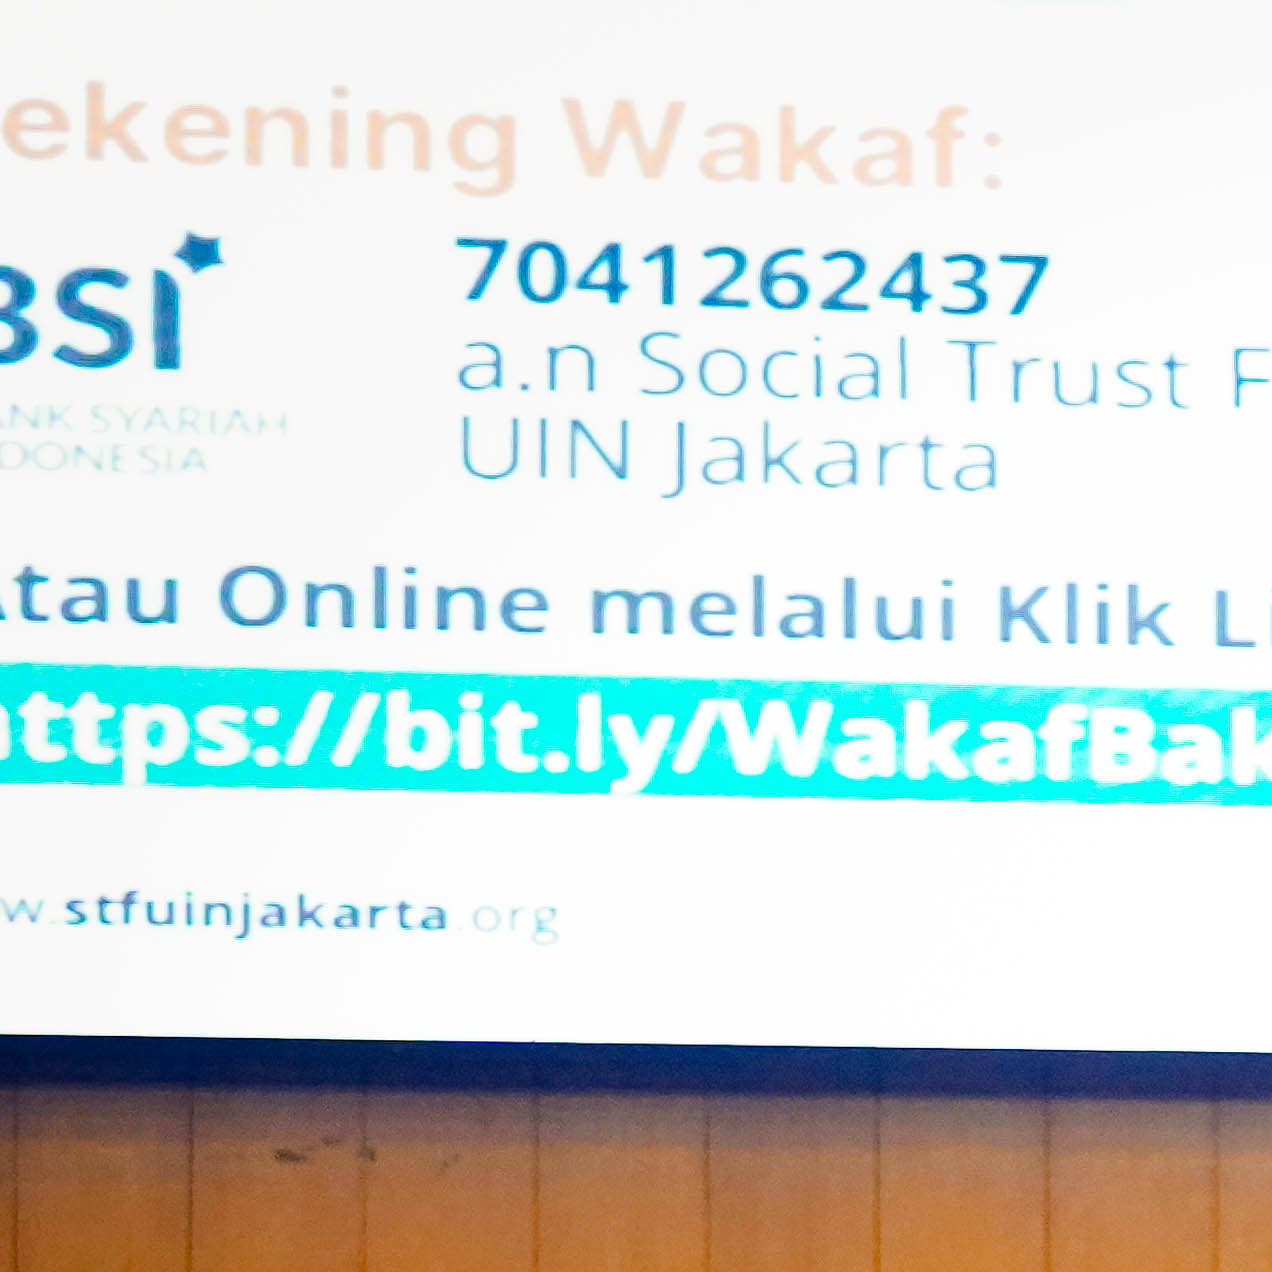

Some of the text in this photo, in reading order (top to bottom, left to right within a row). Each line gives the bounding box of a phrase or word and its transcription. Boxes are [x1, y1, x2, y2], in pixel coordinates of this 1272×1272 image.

[562, 97, 1001, 188] Wakaf:
[454, 237, 1050, 316] 7041262437
[456, 340, 597, 393] a.n
[637, 330, 909, 402] Social
[945, 338, 1189, 410] Trust
[89, 404, 289, 435] SYARIAH
[461, 415, 998, 500] UIN Jakarta
[0, 563, 179, 627] tau
[216, 563, 551, 636] Online
[590, 573, 956, 643] melalui
[999, 581, 1177, 649] Klik
